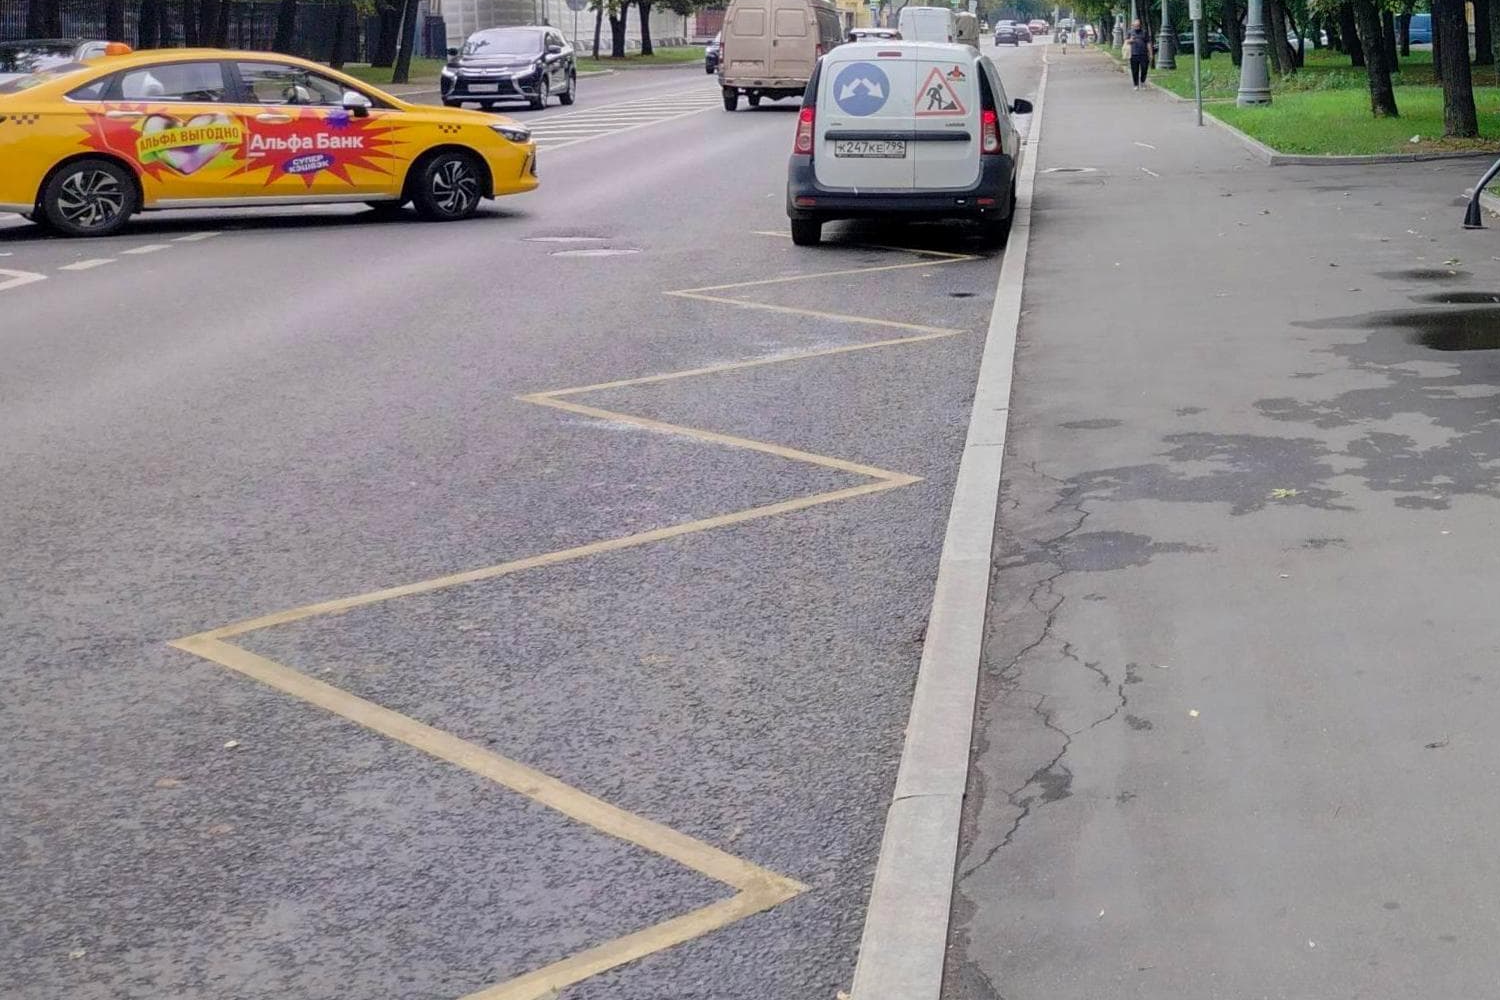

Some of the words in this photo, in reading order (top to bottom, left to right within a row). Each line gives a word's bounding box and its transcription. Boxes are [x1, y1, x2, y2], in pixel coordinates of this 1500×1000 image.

[139, 132, 177, 150] АЛЬФА
[181, 127, 239, 142] ВЫГОДНО
[251, 134, 313, 152] Альфа
[316, 133, 364, 149] Банк
